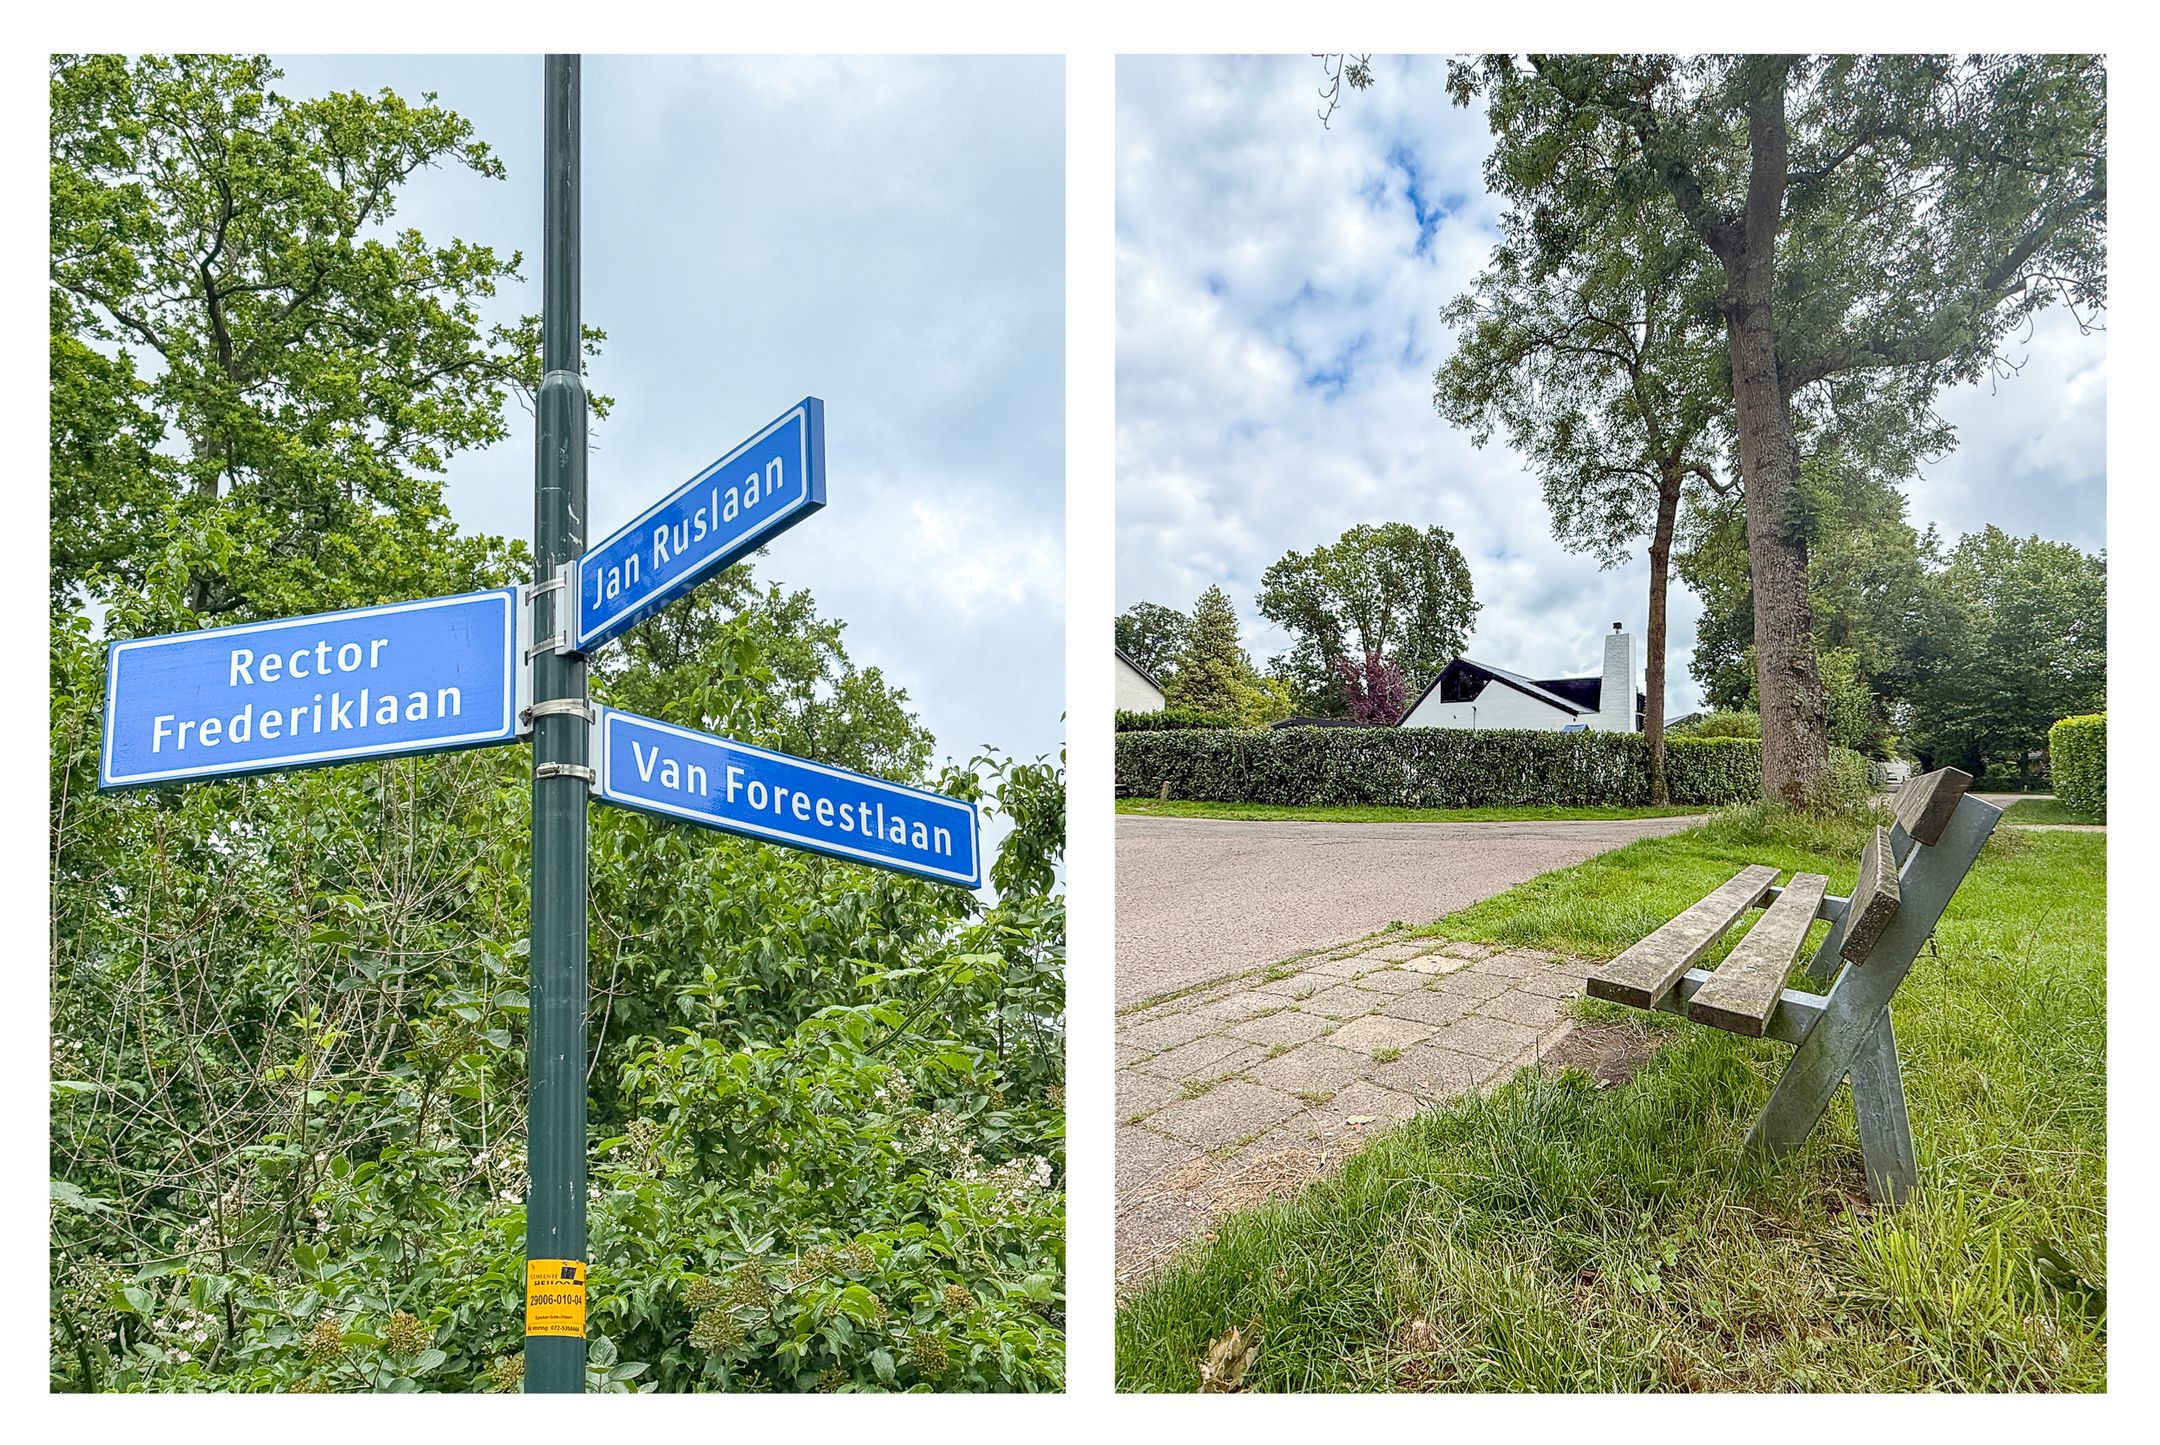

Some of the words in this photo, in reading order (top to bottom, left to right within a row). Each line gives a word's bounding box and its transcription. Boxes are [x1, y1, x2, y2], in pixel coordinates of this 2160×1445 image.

[592, 554, 640, 610] Jan
[653, 454, 785, 571] Ruslaan
[229, 637, 389, 688] Rector
[151, 686, 462, 753] Frederiklaan
[631, 740, 708, 797] Van
[726, 765, 953, 857] Foreestlaan
[530, 1294, 582, 1306] 29006-010-04
